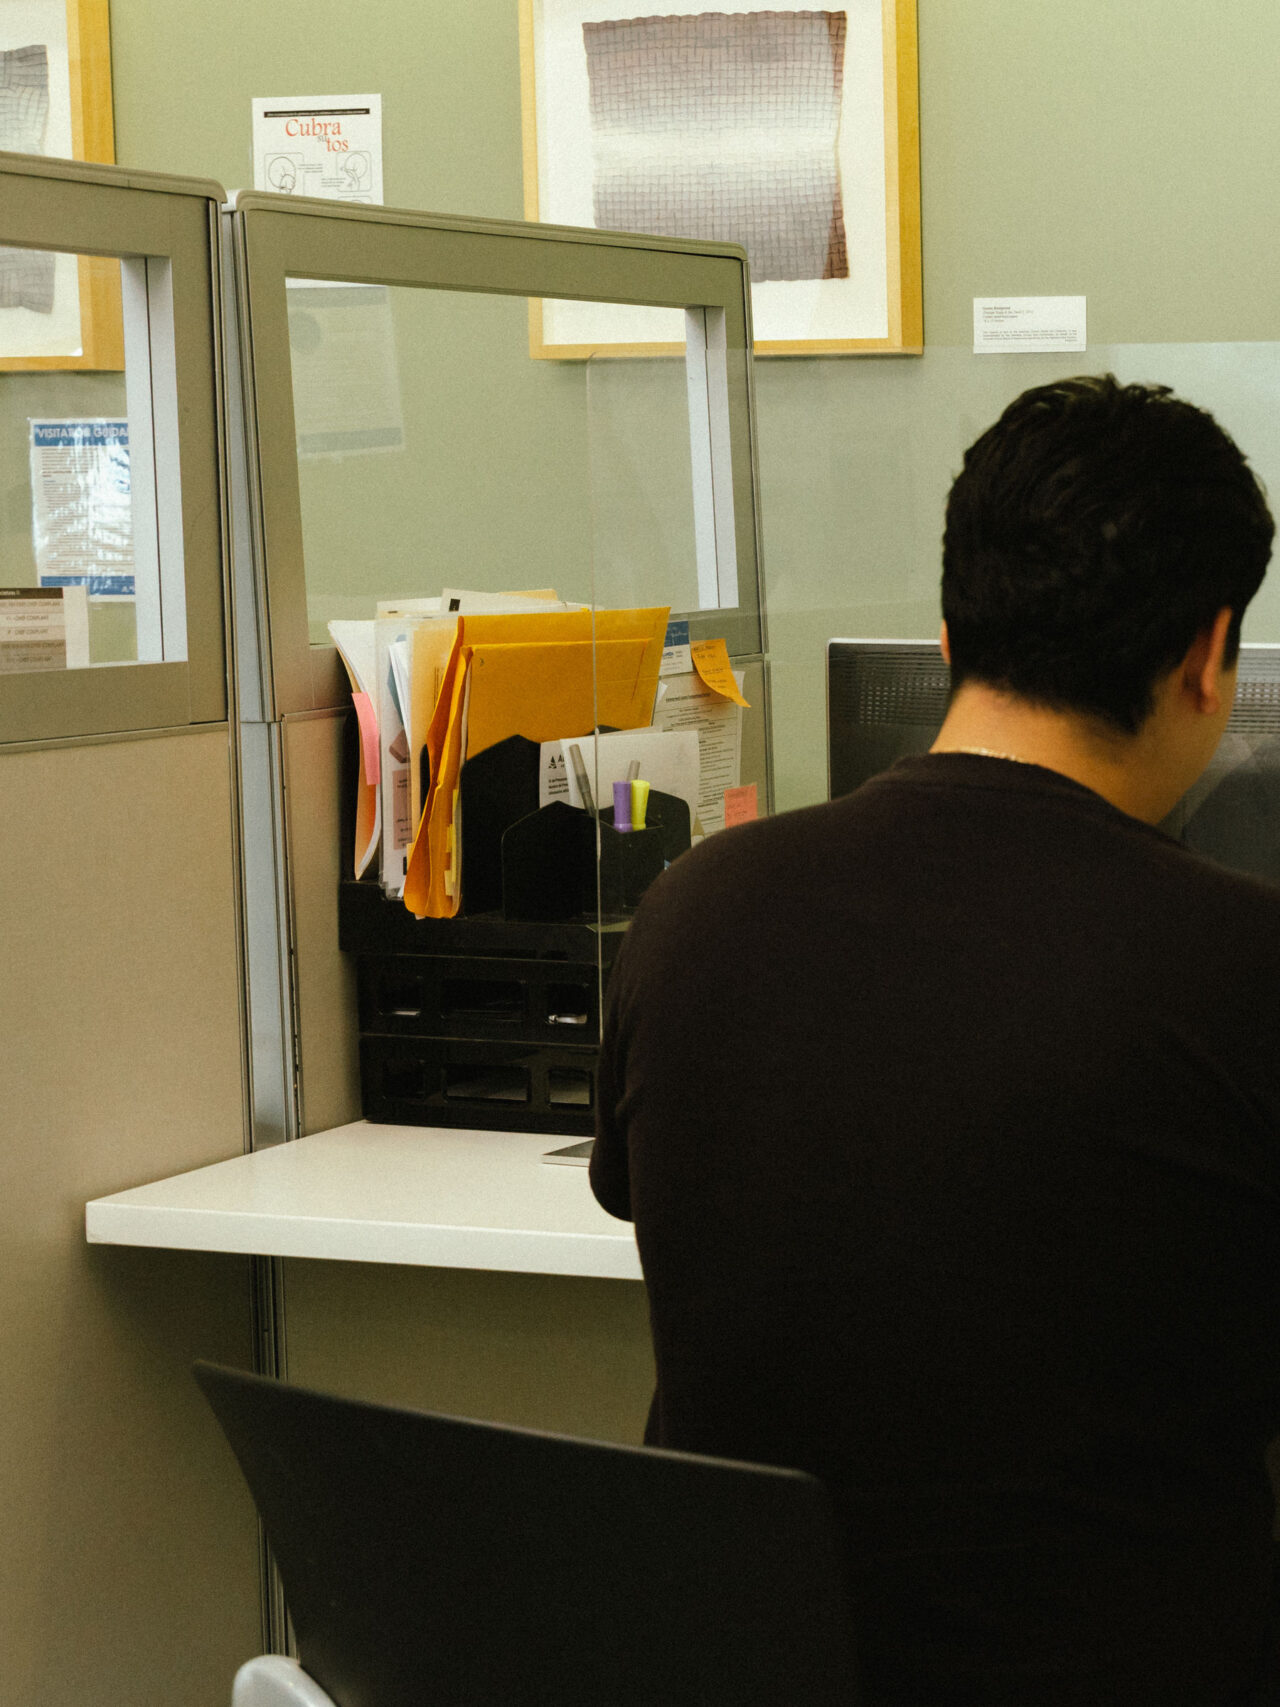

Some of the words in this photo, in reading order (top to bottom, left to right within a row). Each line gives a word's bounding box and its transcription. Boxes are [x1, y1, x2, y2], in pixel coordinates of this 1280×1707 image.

[285, 118, 342, 137] Cubra
[326, 137, 349, 152] tos
[94, 427, 128, 437] GUIDA
